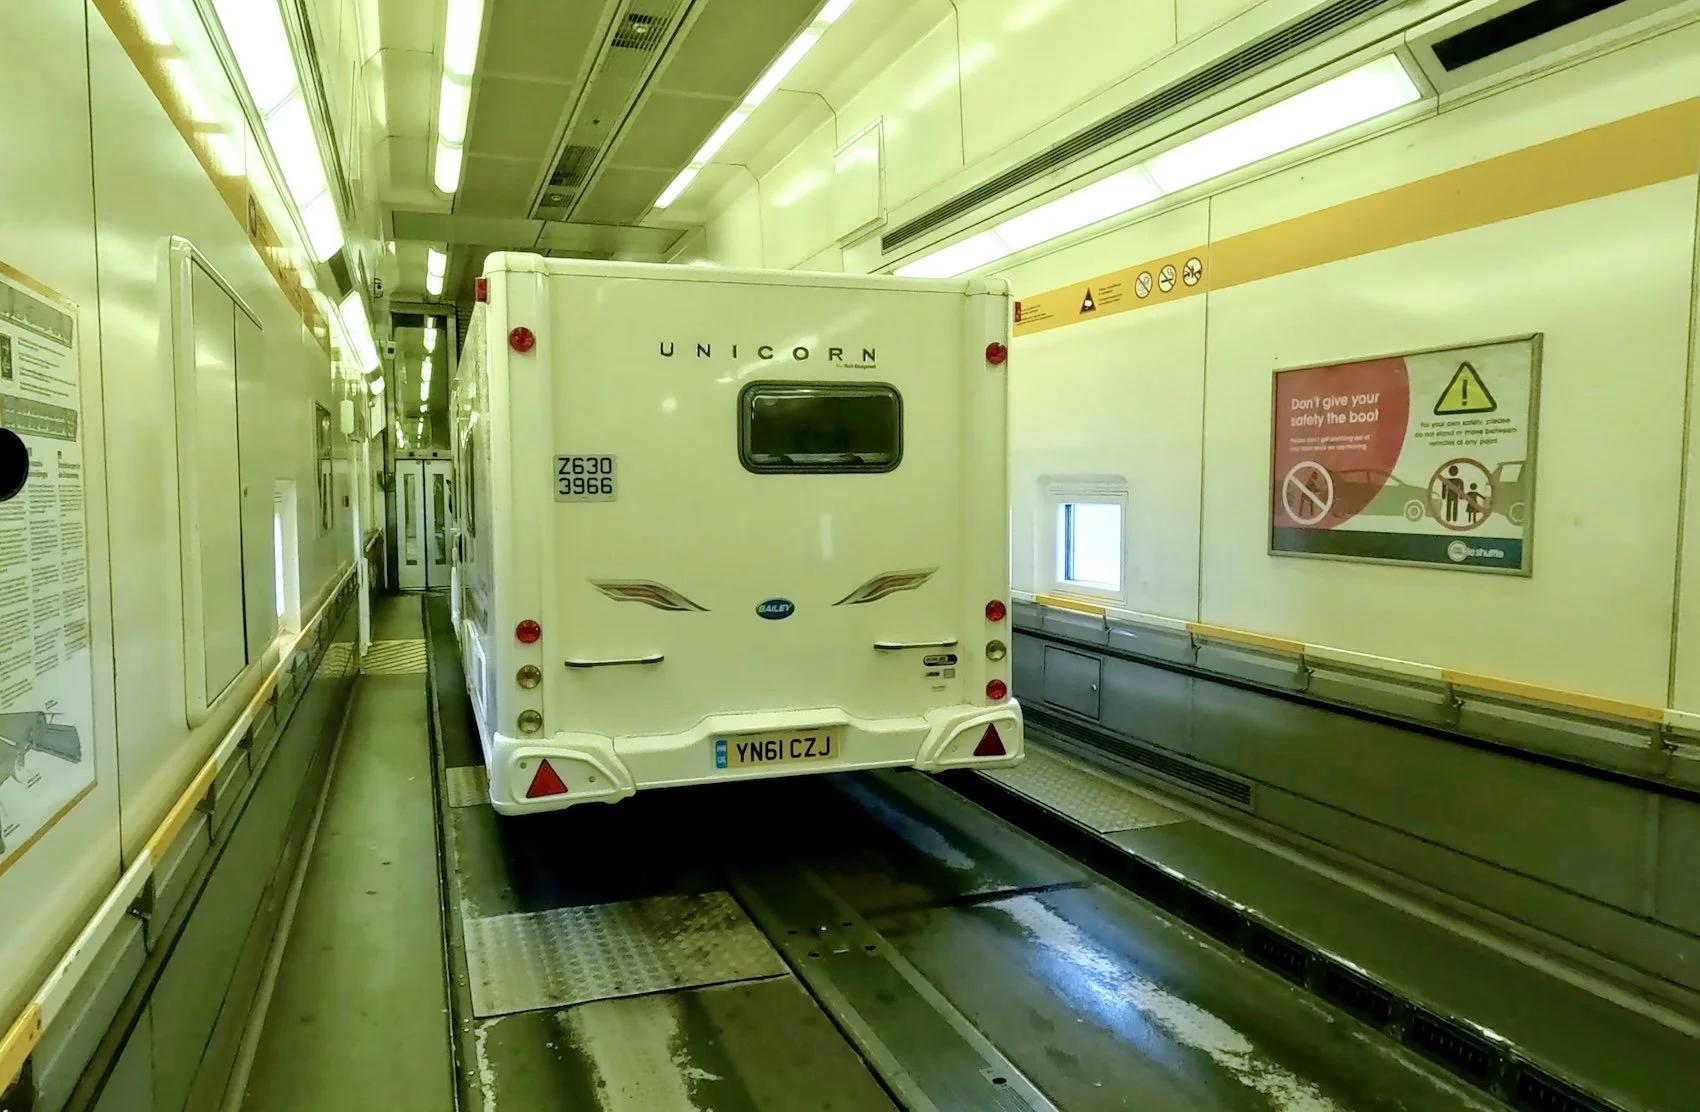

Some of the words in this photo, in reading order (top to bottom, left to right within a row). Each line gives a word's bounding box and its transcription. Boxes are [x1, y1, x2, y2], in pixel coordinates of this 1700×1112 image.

[660, 341, 876, 362] UNICORN
[1291, 396, 1320, 410] Don't
[1322, 394, 1348, 411] give
[1352, 392, 1380, 408] your
[1290, 412, 1325, 427] safety
[1326, 411, 1347, 424] the
[1349, 408, 1379, 423] boot
[558, 457, 612, 475] Z630
[559, 477, 613, 495] 3966
[758, 603, 792, 613] BAILEY
[736, 740, 783, 763] YN61
[790, 736, 831, 759] CZJ
